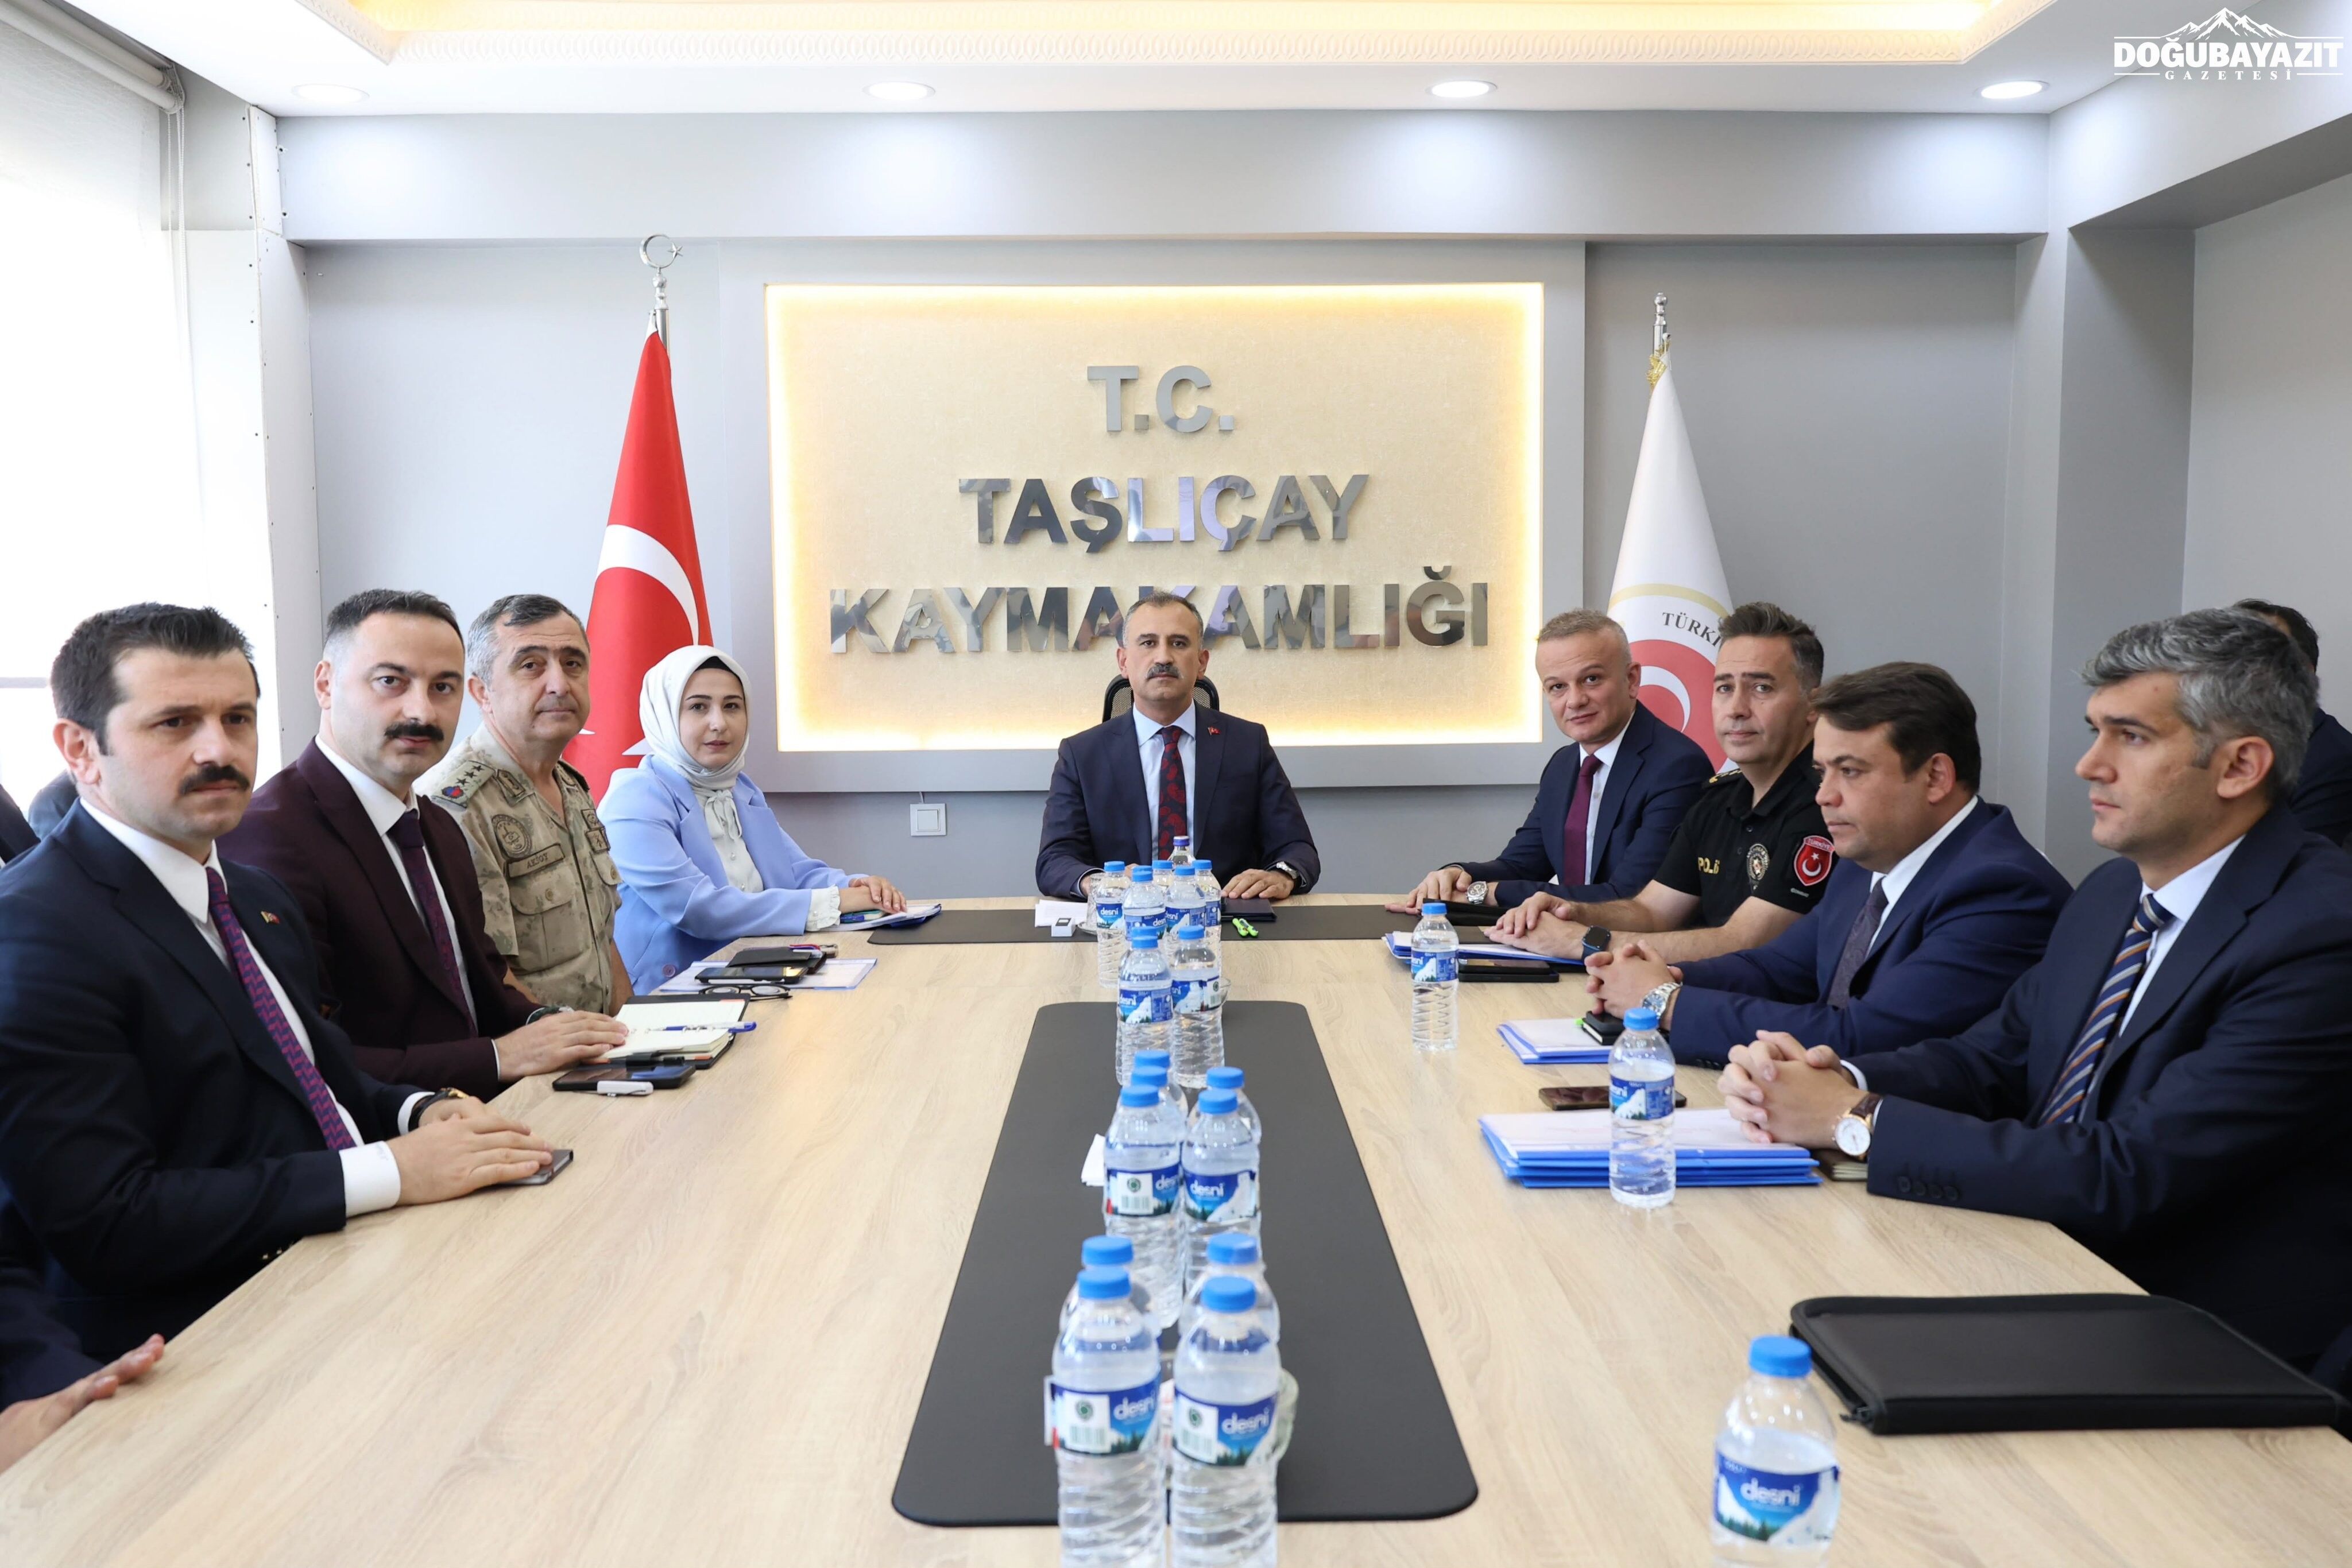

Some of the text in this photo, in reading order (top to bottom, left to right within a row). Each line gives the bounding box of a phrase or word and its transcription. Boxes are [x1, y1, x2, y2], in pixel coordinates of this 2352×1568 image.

[1087, 365, 1235, 432] T.C.
[958, 474, 1370, 553] TAŞLIÇAY
[830, 566, 1488, 654] KAYMAAMLIĞI
[1152, 917, 1166, 926] desn
